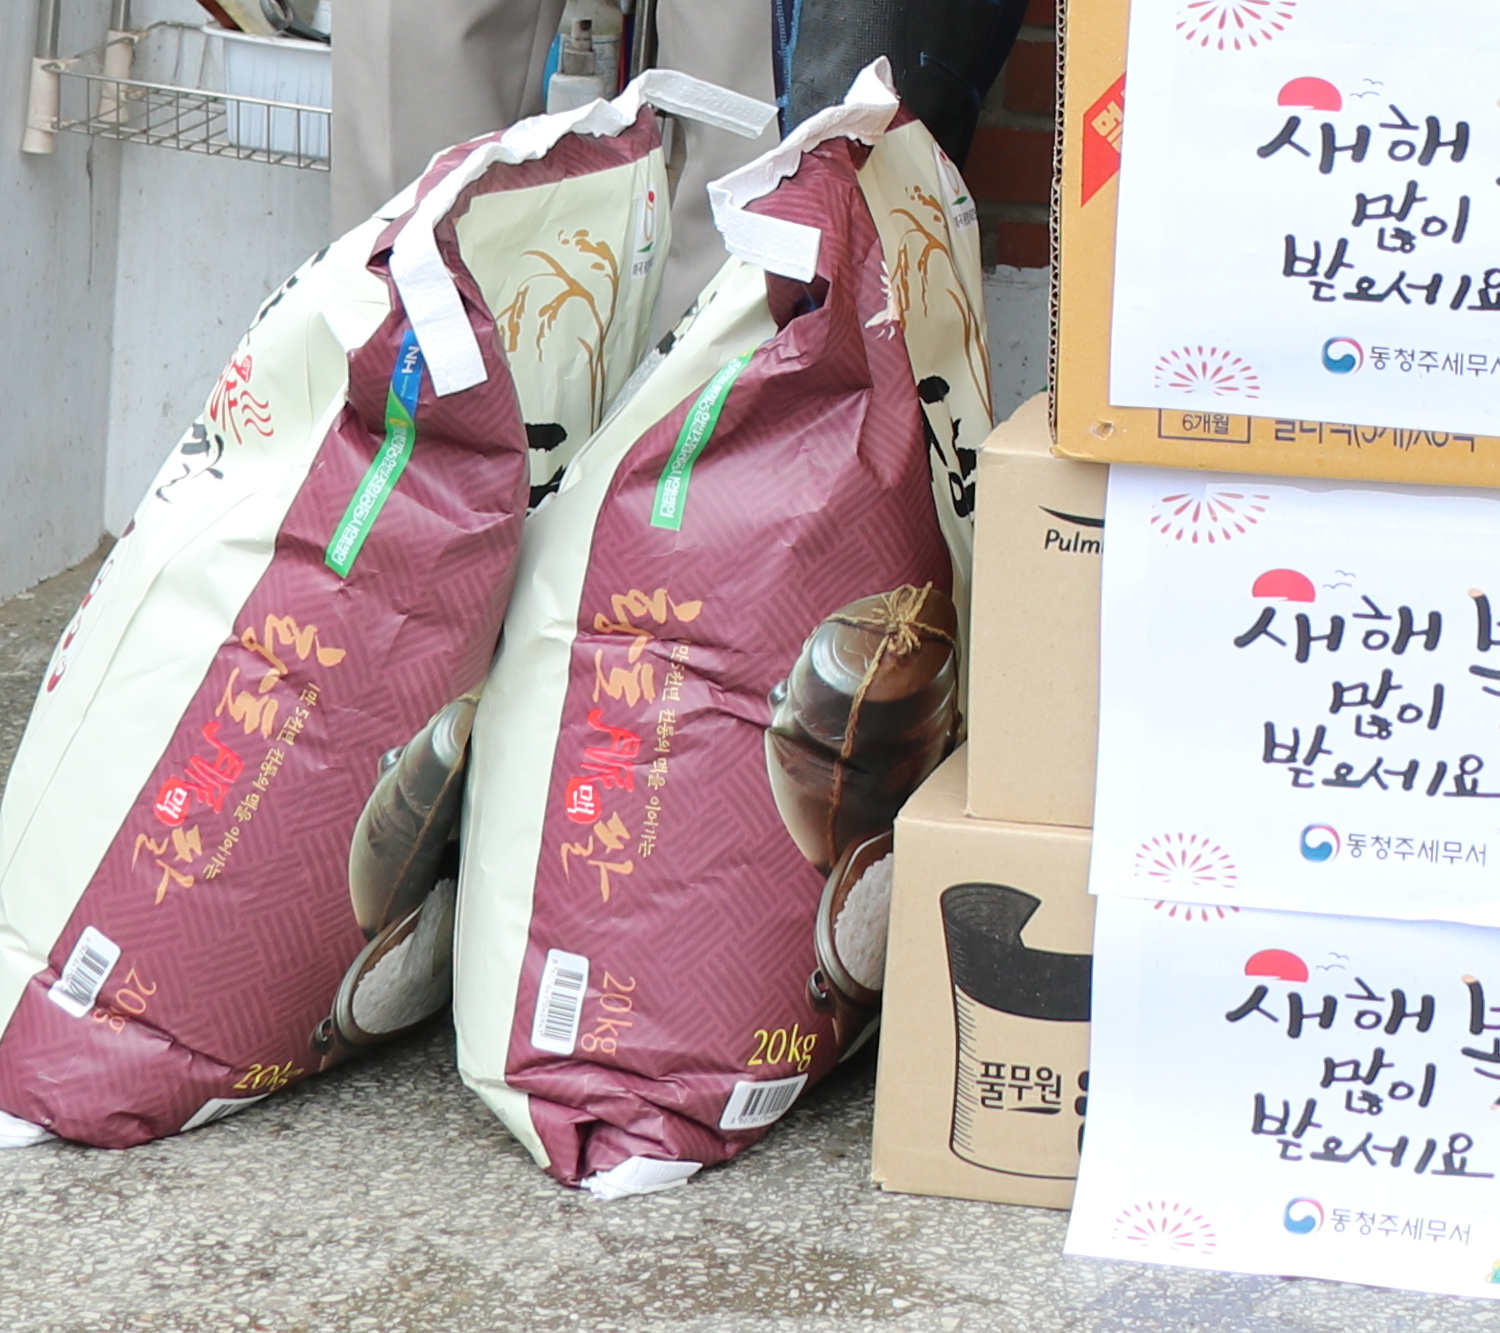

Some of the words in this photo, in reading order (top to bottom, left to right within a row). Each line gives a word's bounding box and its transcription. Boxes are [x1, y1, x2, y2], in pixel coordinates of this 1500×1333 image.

[1257, 104, 1470, 173] 새해
[1352, 180, 1470, 254] 많이
[401, 345, 421, 374] NH
[1182, 413, 1230, 435] 6개월
[1232, 595, 1443, 663] 새해
[1327, 669, 1445, 739] 많이
[654, 708, 677, 753] 전통의
[252, 748, 285, 792] 전통의
[647, 757, 668, 790] 맥을
[234, 793, 261, 823] 맥을
[638, 795, 662, 859] 이어가는
[202, 826, 241, 880] 이어가는
[1345, 829, 1489, 868] 동청주세무서
[580, 971, 637, 1057] 20kg
[1224, 975, 1436, 1039] 새해
[746, 1022, 820, 1073] 20kg
[976, 1059, 1063, 1109] 풀무원
[1318, 1047, 1437, 1115] 많이
[1251, 1092, 1495, 1177] 받으세요
[1329, 1206, 1472, 1246] 동청주세무서
